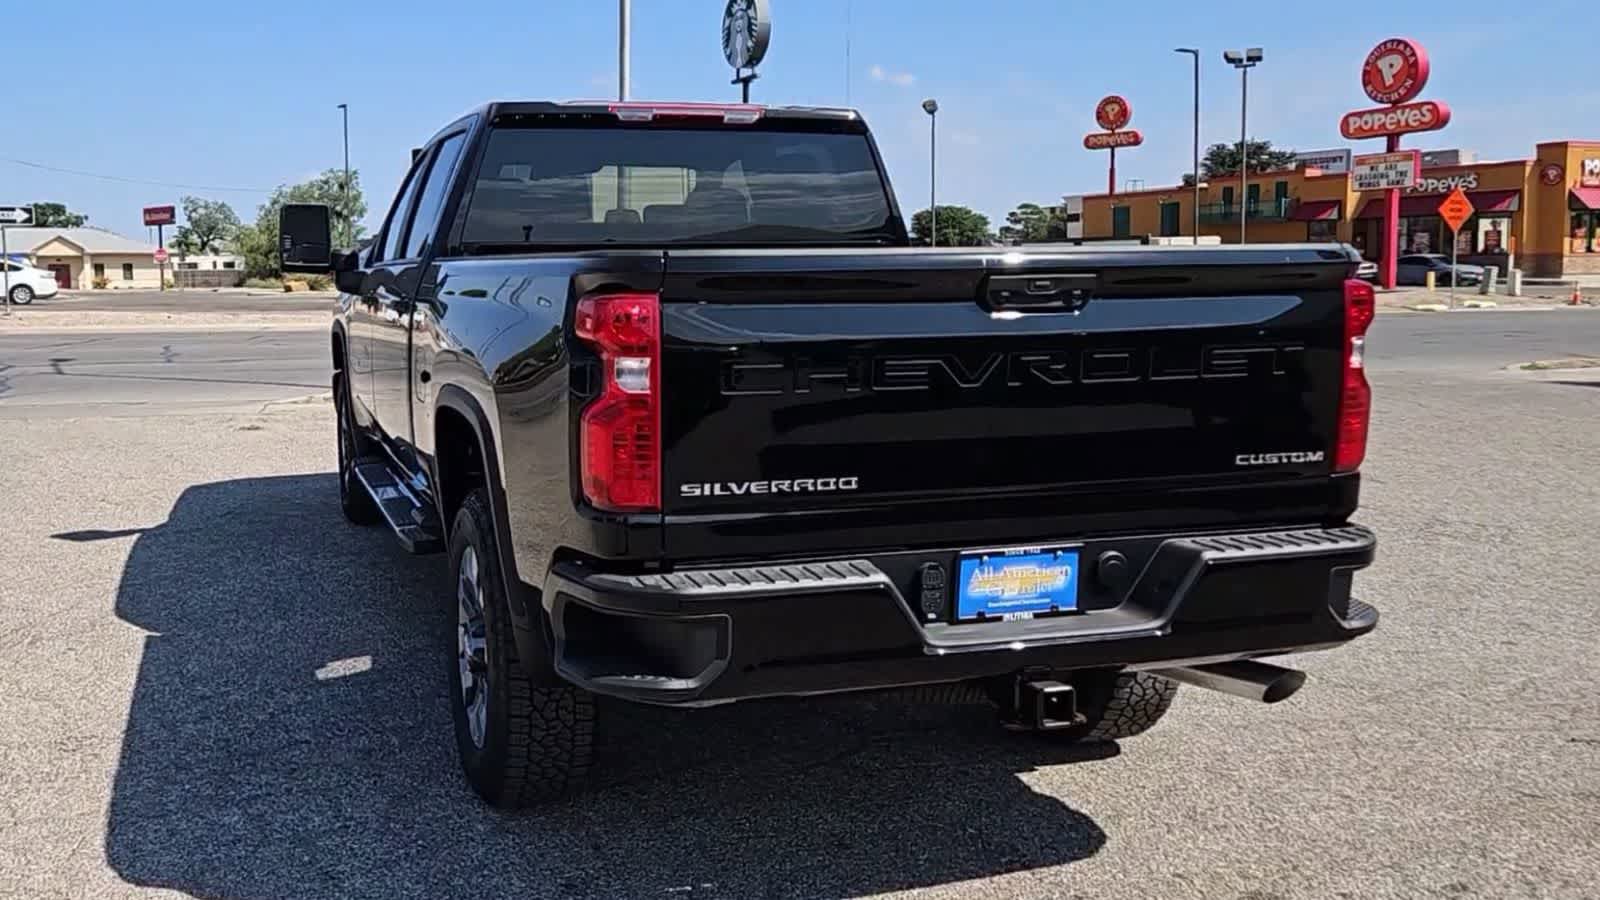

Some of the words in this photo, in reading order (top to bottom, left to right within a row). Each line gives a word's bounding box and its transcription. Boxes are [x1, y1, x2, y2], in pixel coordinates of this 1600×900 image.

[1376, 54, 1404, 87] P
[719, 346, 1305, 396] CHEVROLET
[1235, 450, 1324, 466] CUSTOM
[680, 476, 859, 497] SILVERADO
